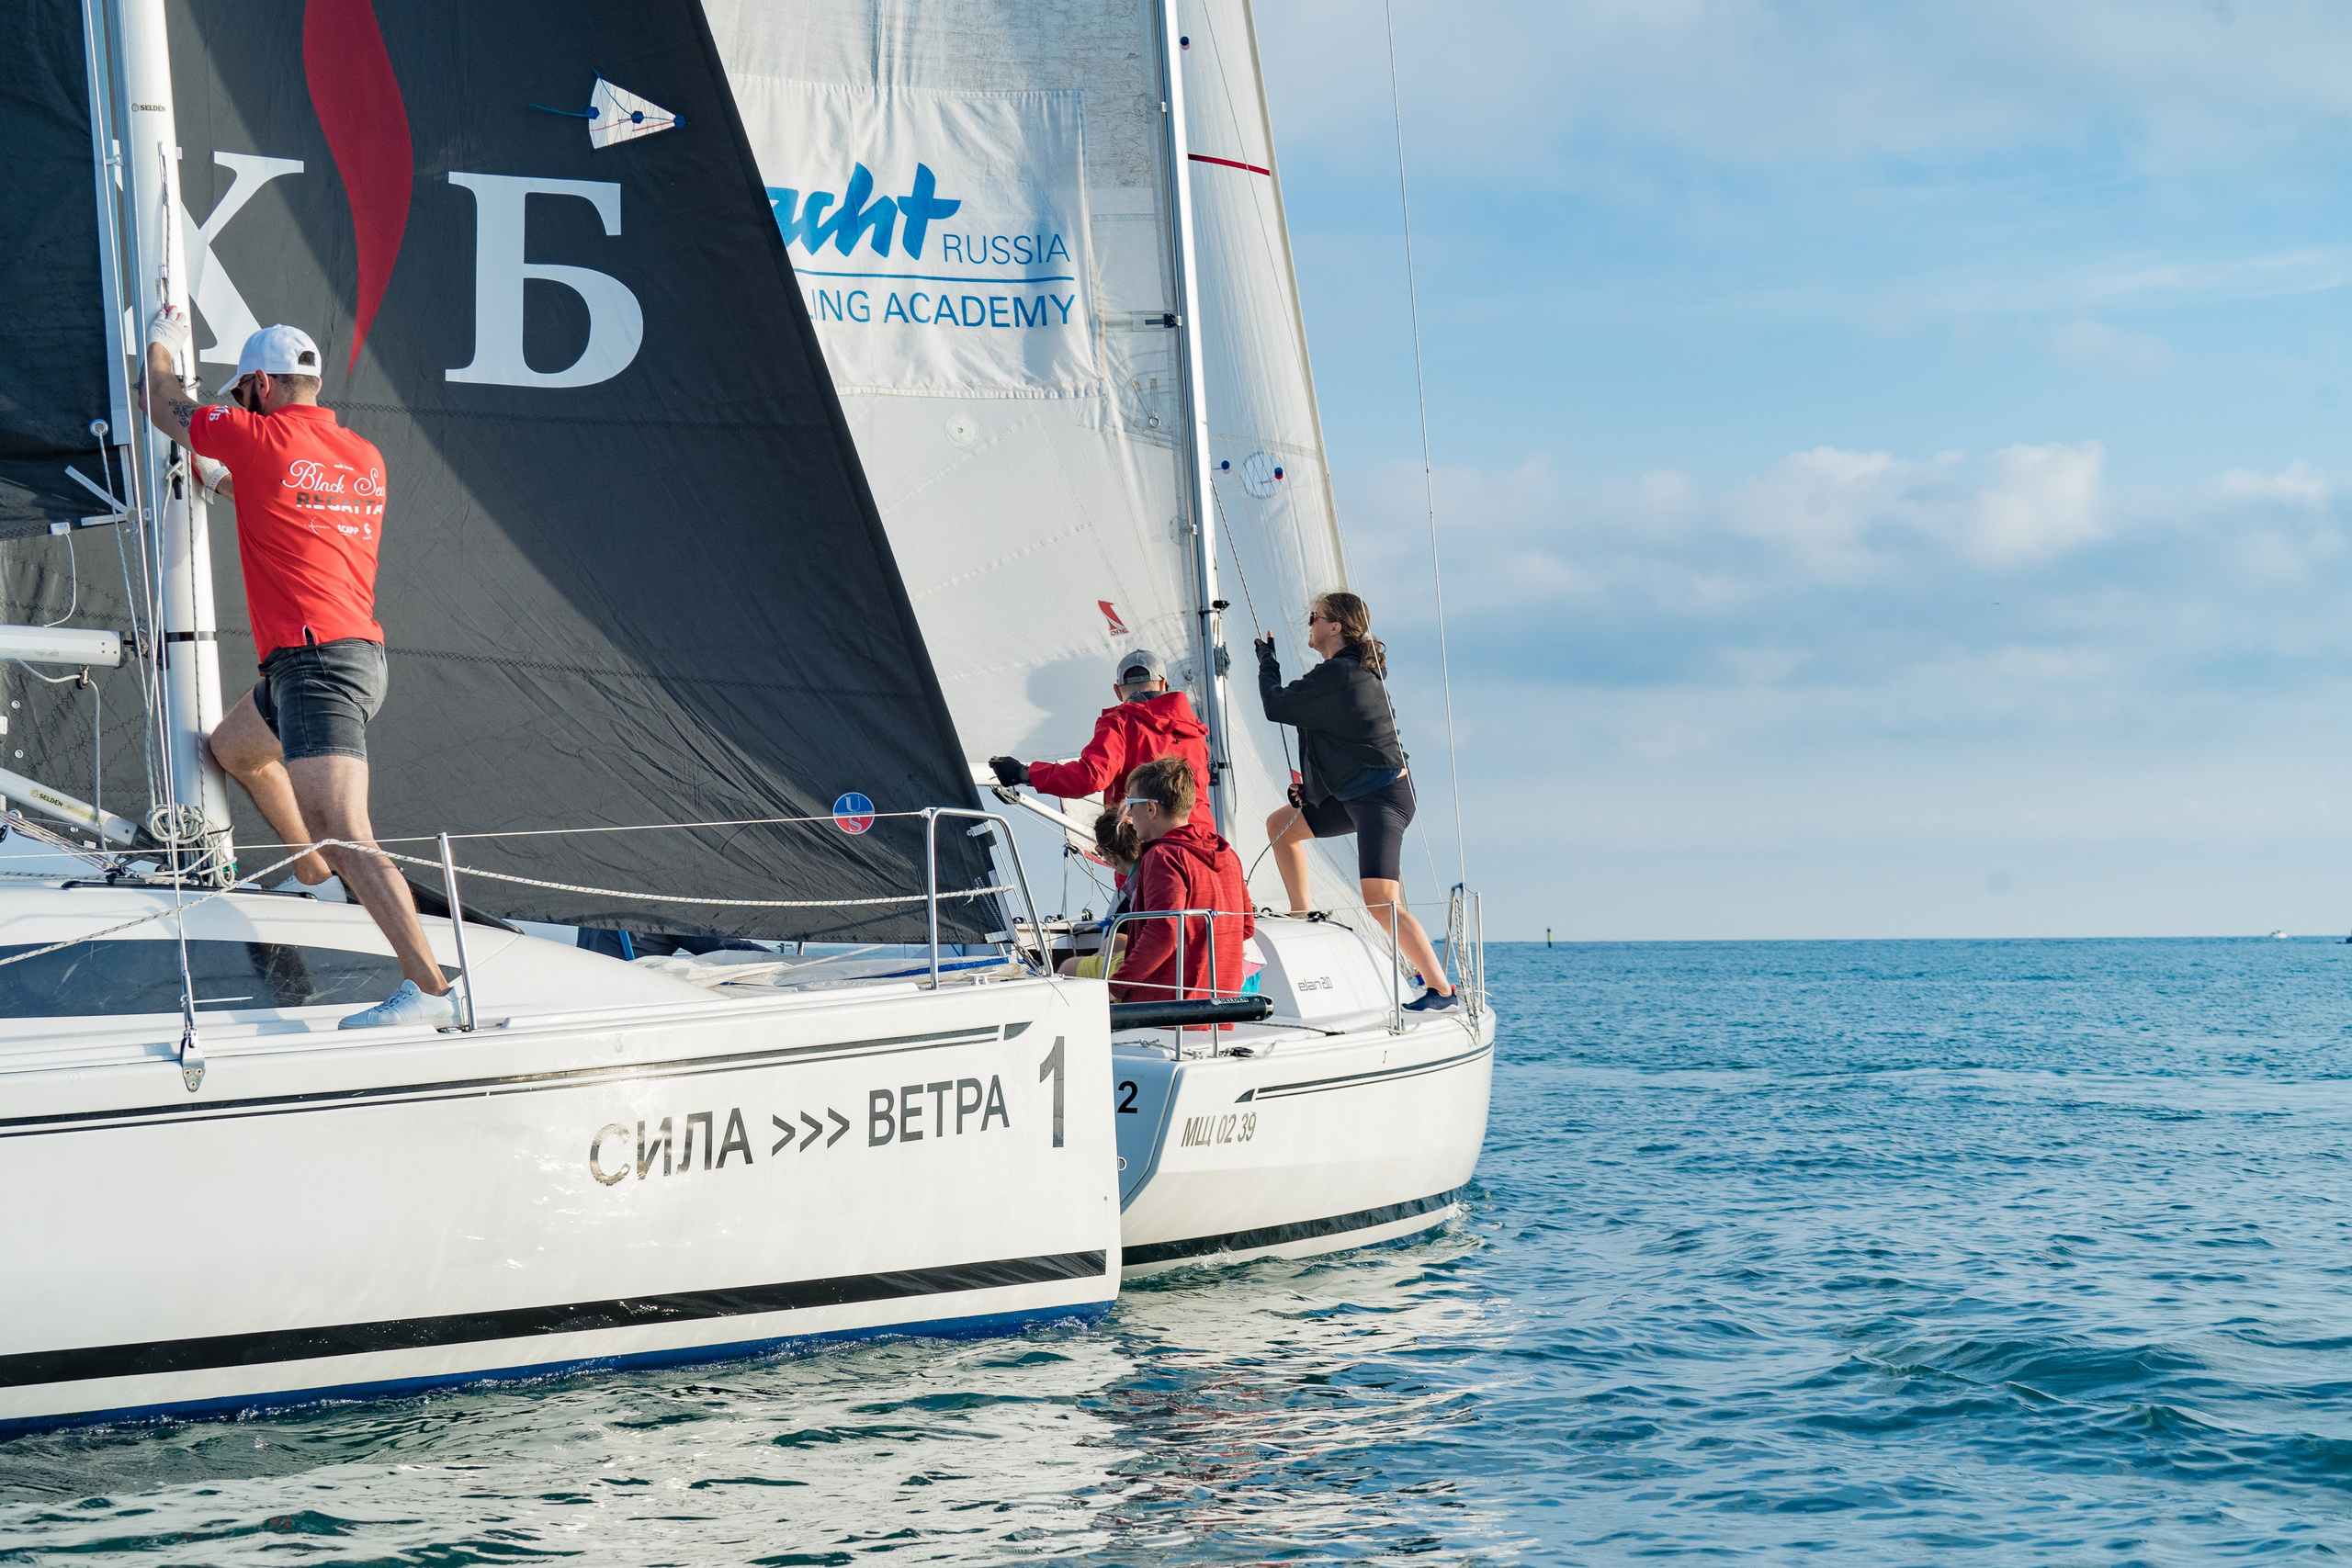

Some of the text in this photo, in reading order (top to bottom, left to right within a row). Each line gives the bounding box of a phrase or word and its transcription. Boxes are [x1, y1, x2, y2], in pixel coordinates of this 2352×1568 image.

[943, 233, 1071, 265] RUSSIA
[446, 172, 643, 388] Б
[808, 289, 1075, 328] ING ACADEMY
[280, 459, 345, 494] Black
[296, 491, 383, 515] REGATTA
[1039, 1036, 1065, 1148] 1
[1117, 1080, 1138, 1114] 2
[589, 1074, 1011, 1187] СИЛА ВЕТРА
[1181, 1111, 1257, 1147] МЩ 02 39
